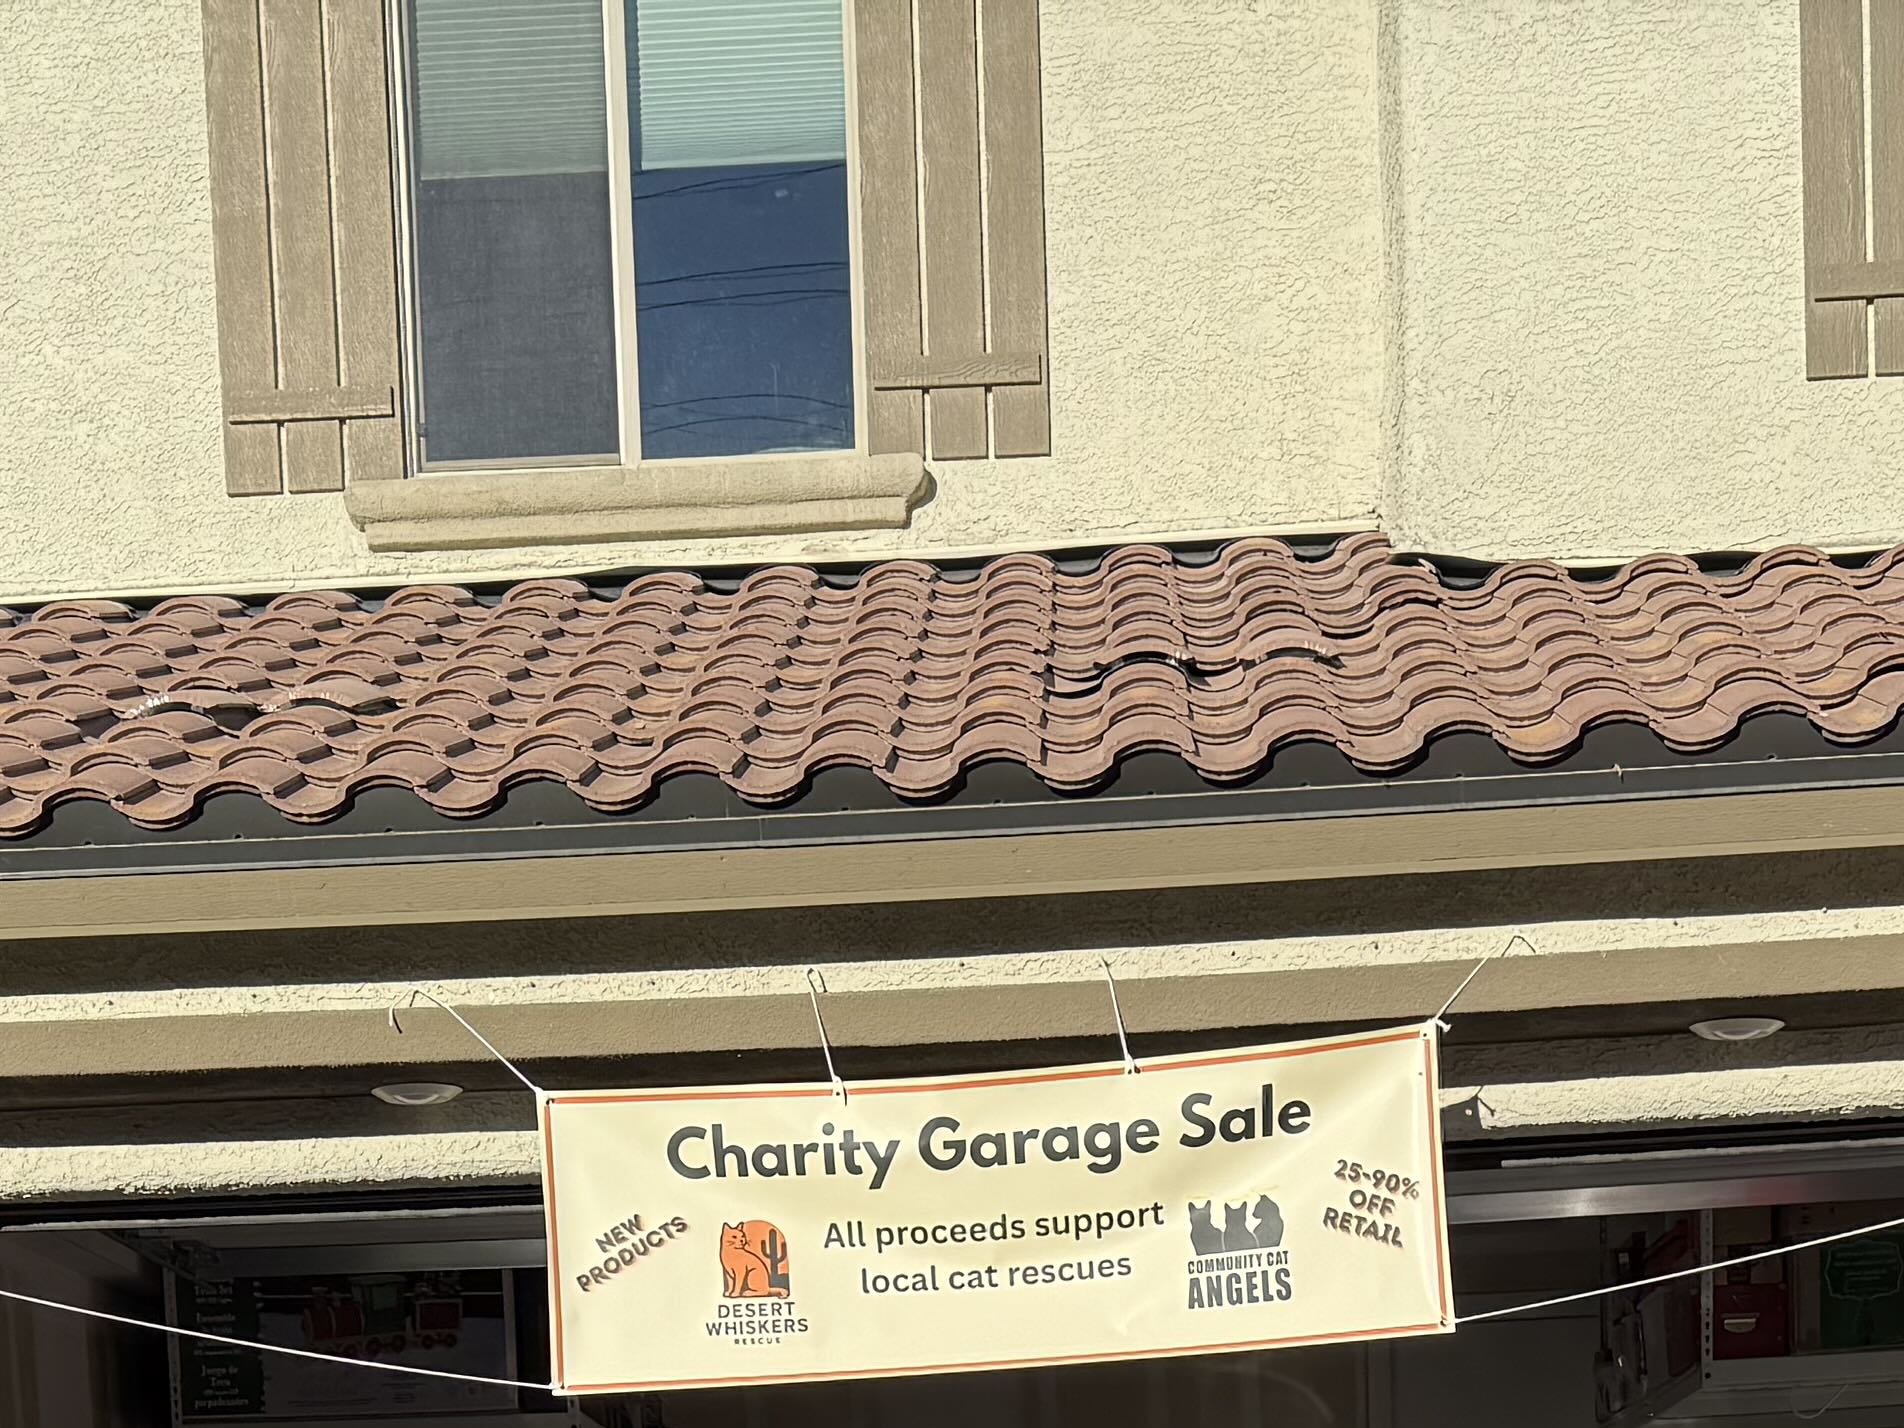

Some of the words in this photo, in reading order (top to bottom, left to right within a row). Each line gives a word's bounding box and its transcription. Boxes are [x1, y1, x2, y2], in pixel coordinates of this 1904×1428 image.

[667, 1122, 900, 1190] Charity
[918, 1116, 1160, 1174] Garage
[1179, 1083, 1312, 1148] Sale
[1334, 1159, 1420, 1200] 25-90%
[1349, 1189, 1396, 1217] OFF
[596, 1214, 645, 1253] NEW
[824, 1221, 866, 1248] All
[876, 1213, 1026, 1253] proceeds
[1035, 1201, 1165, 1241] support
[1322, 1207, 1404, 1248] RETAIL
[576, 1216, 690, 1292] PRODUCTS
[1188, 1252, 1263, 1274] COMMUNITY
[1267, 1250, 1289, 1266] CAT
[861, 1264, 939, 1295] local
[948, 1264, 999, 1290] cat
[1008, 1257, 1132, 1287] rescues
[1188, 1268, 1292, 1309] ANGELS
[706, 1318, 808, 1337] WHISKERS
[718, 1302, 795, 1319] DESERT
[734, 1336, 781, 1345] RESCUE
